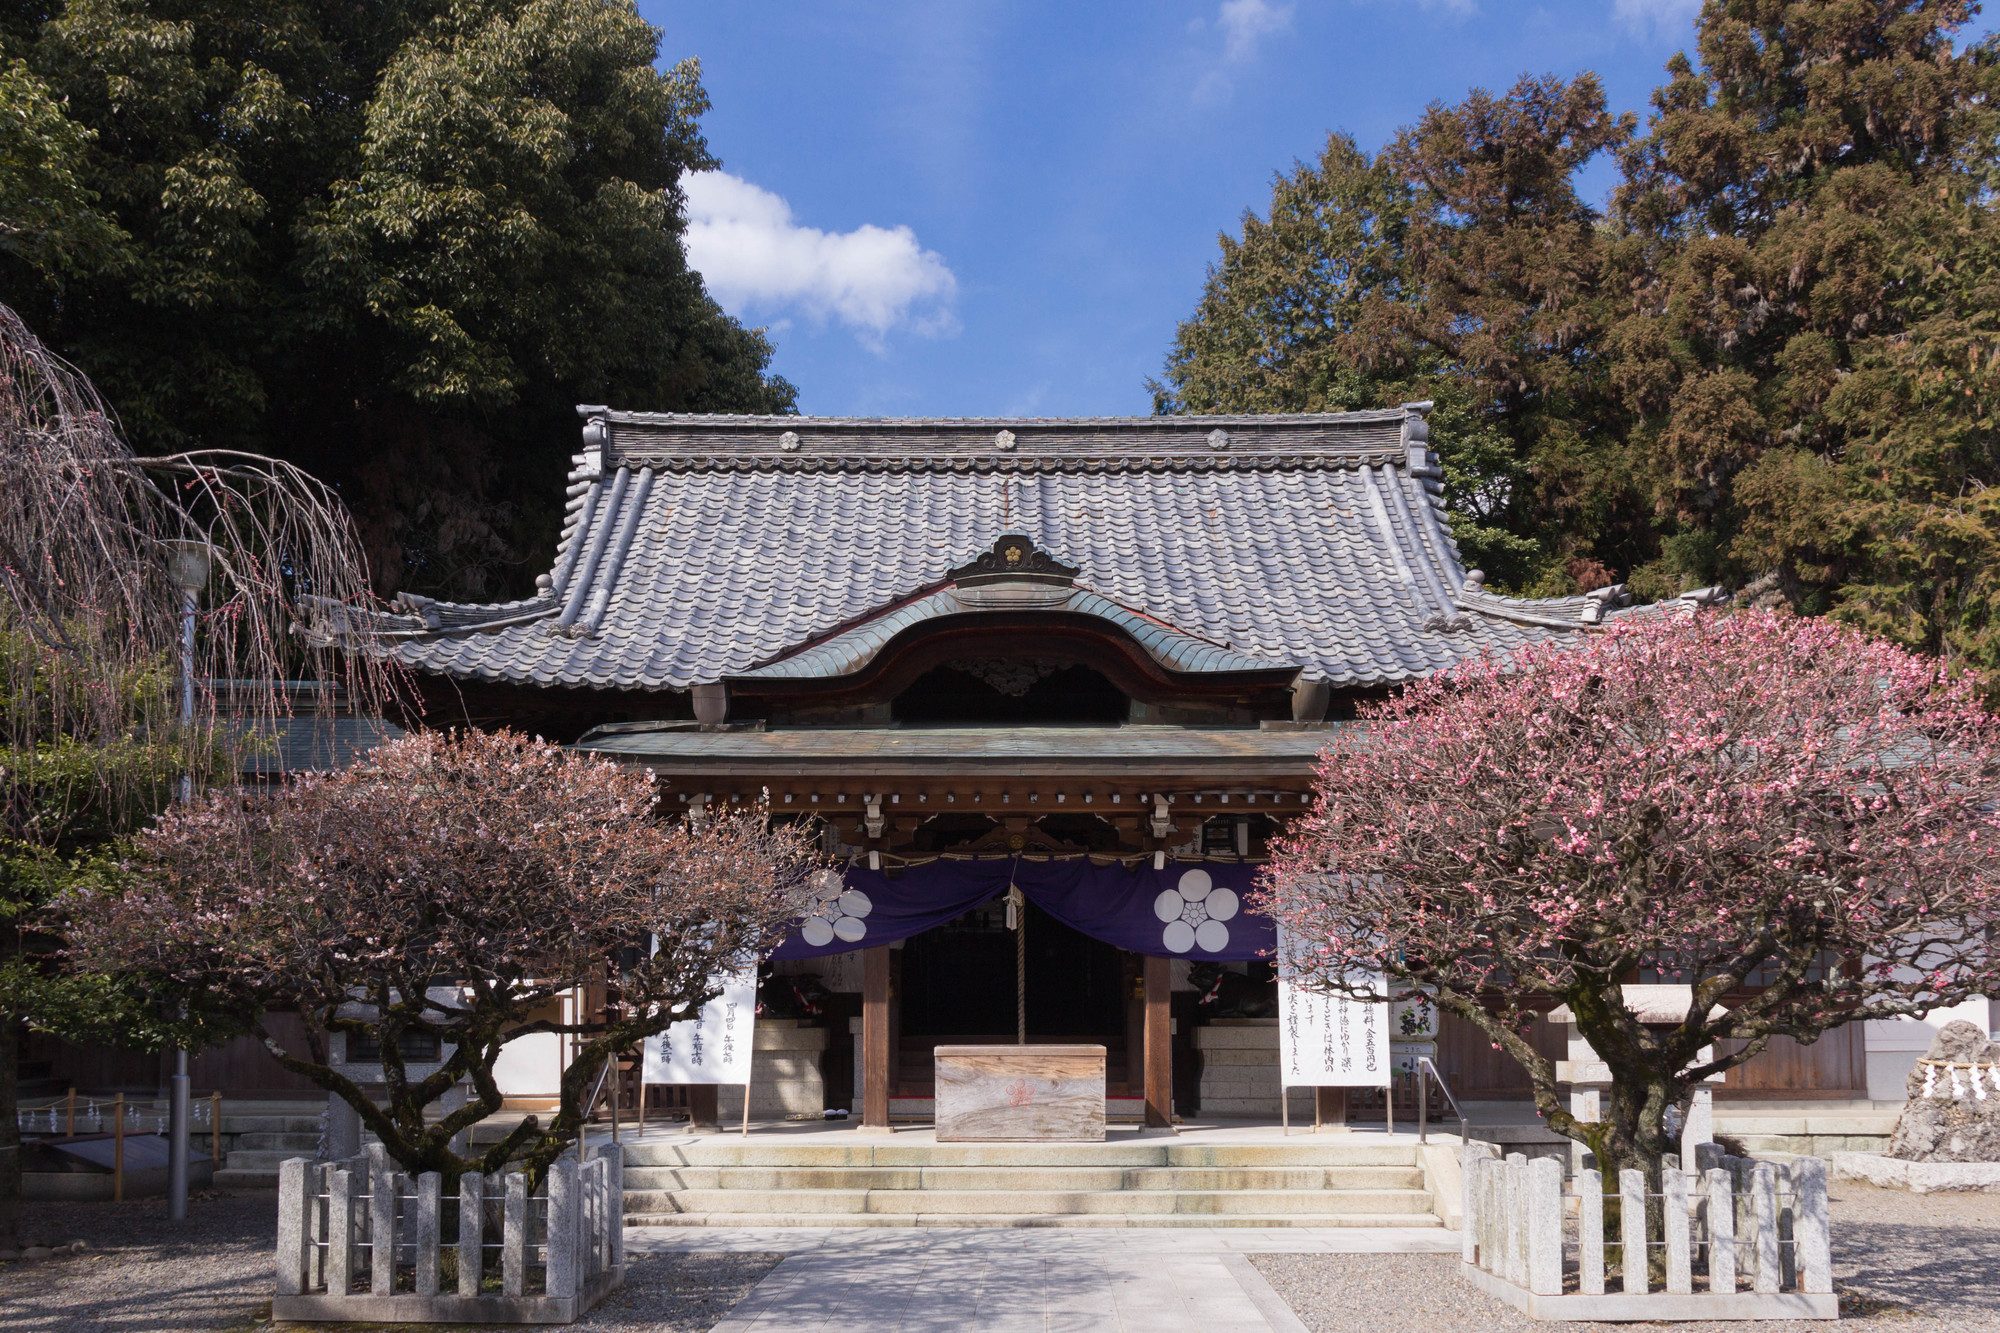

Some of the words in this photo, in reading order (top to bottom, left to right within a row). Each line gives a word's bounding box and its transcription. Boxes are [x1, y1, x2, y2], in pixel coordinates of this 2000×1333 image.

[660, 1033, 673, 1064] 午後二時
[691, 1033, 703, 1066] 午前十時
